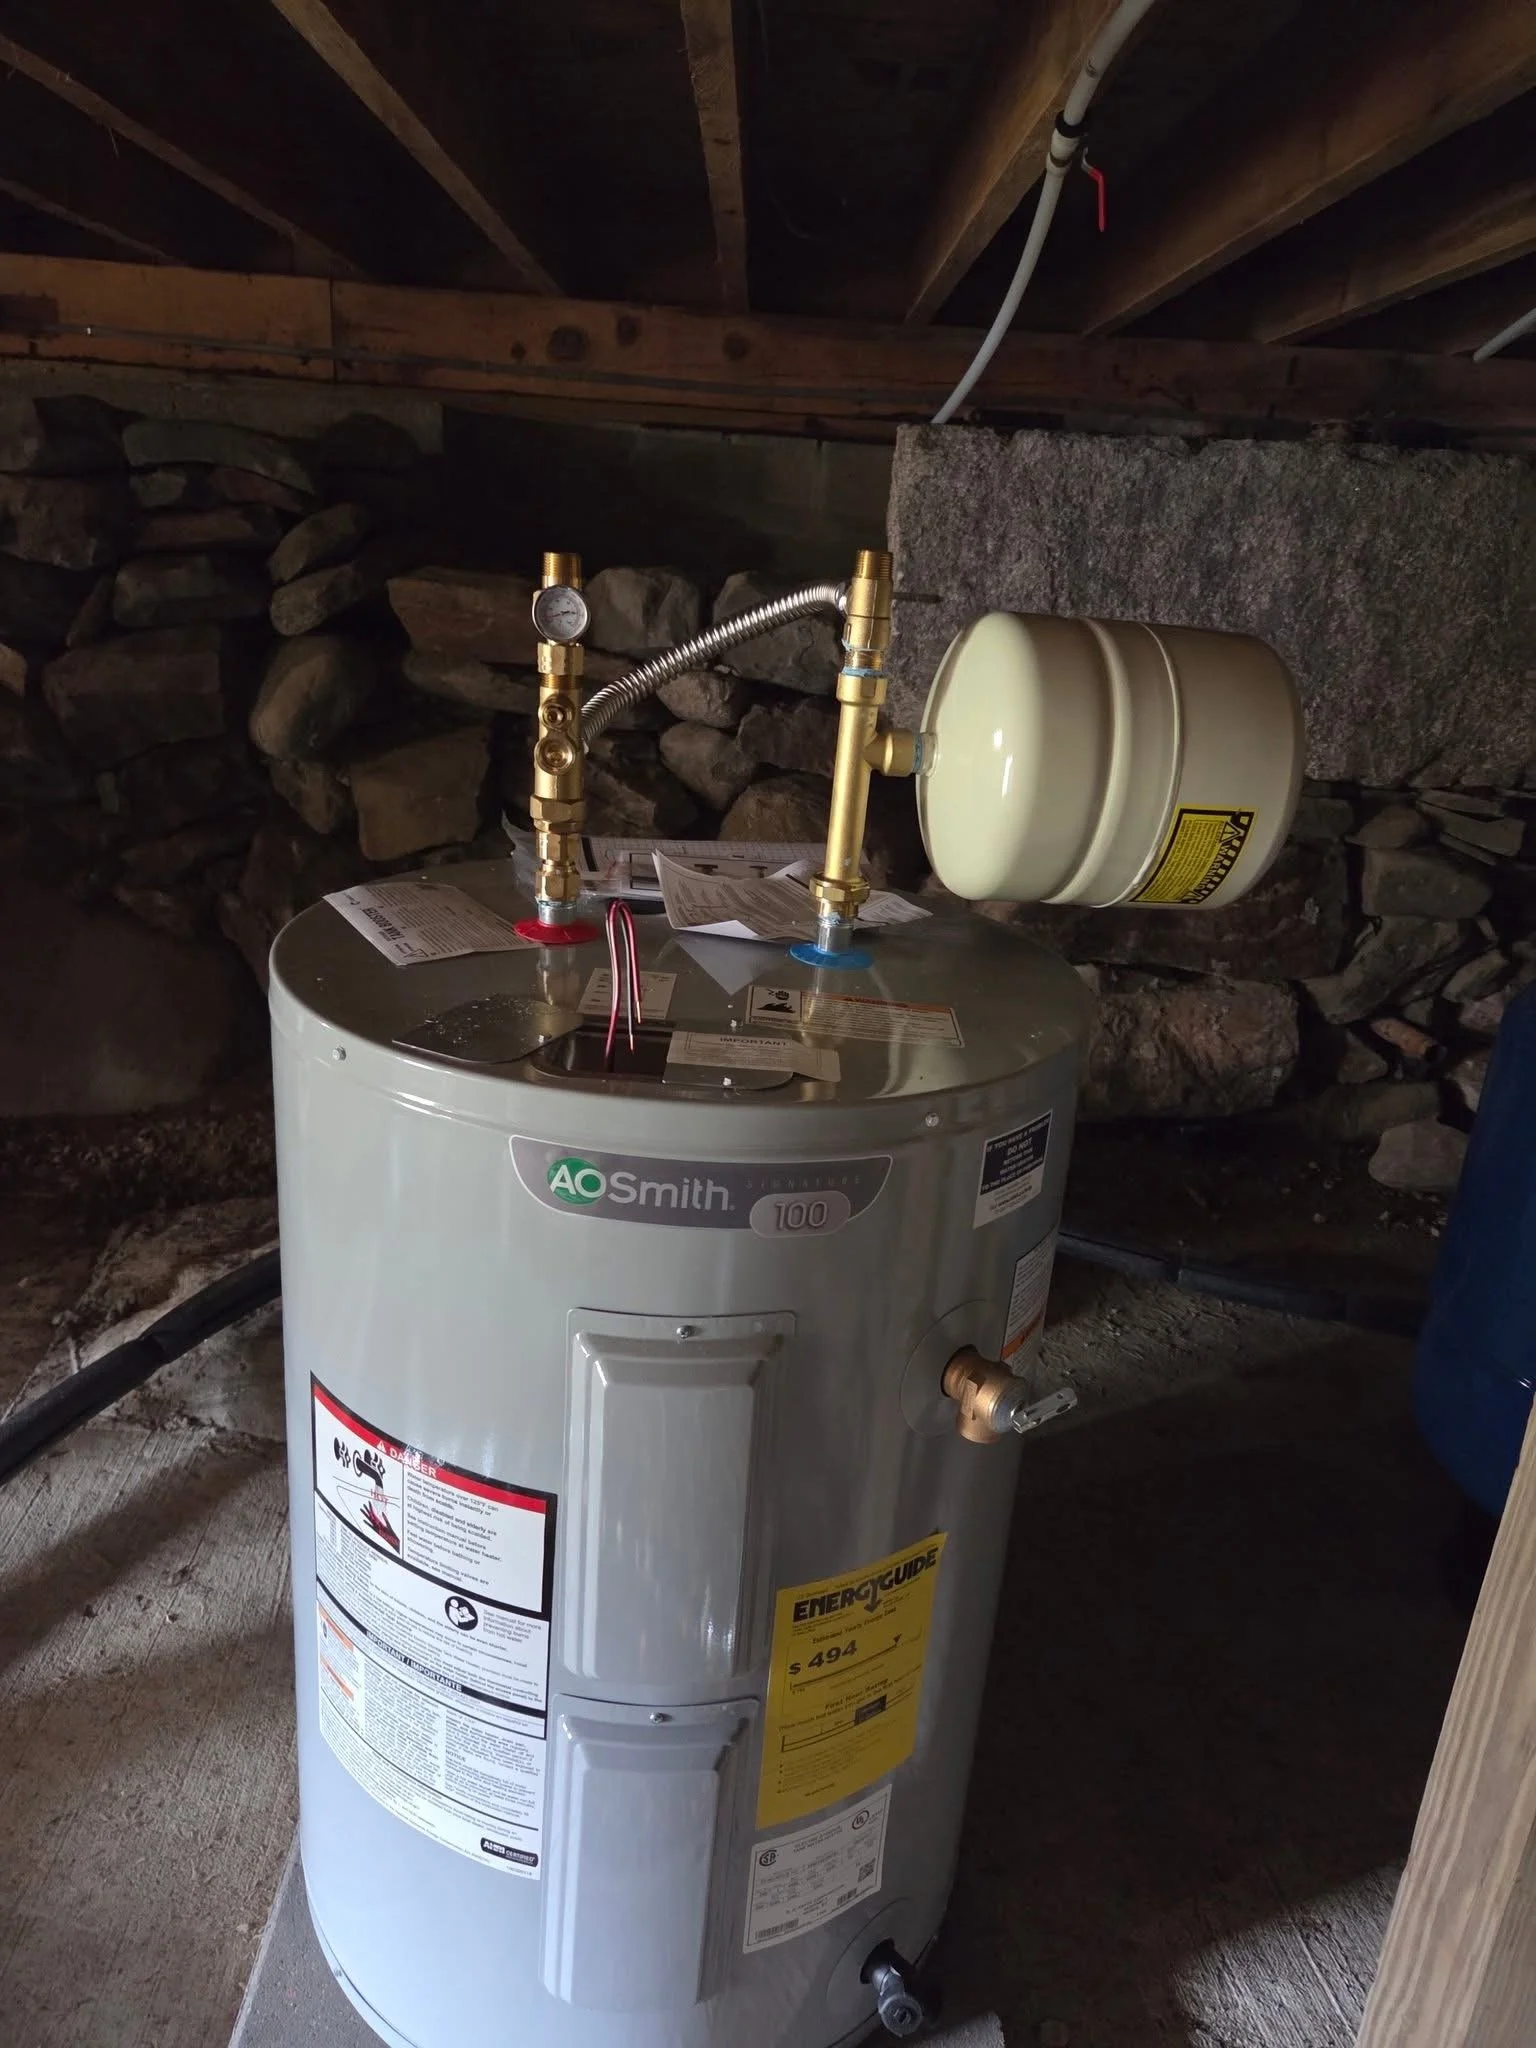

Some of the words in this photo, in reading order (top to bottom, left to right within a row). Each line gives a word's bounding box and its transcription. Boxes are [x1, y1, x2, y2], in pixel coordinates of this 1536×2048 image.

[1198, 845, 1230, 889] WARNING
[719, 1036, 788, 1047] IMPORTANT
[1007, 1145, 1018, 1156] DO
[1018, 1137, 1033, 1150] NOT
[745, 1176, 862, 1190] SIGNATURE
[774, 1200, 829, 1230] 100
[792, 1546, 939, 1622] ENERGYGUIDE
[367, 1630, 405, 1662] IMPORTANT
[410, 1661, 463, 1692] IMPORTANTE
[807, 1639, 858, 1669] 494
